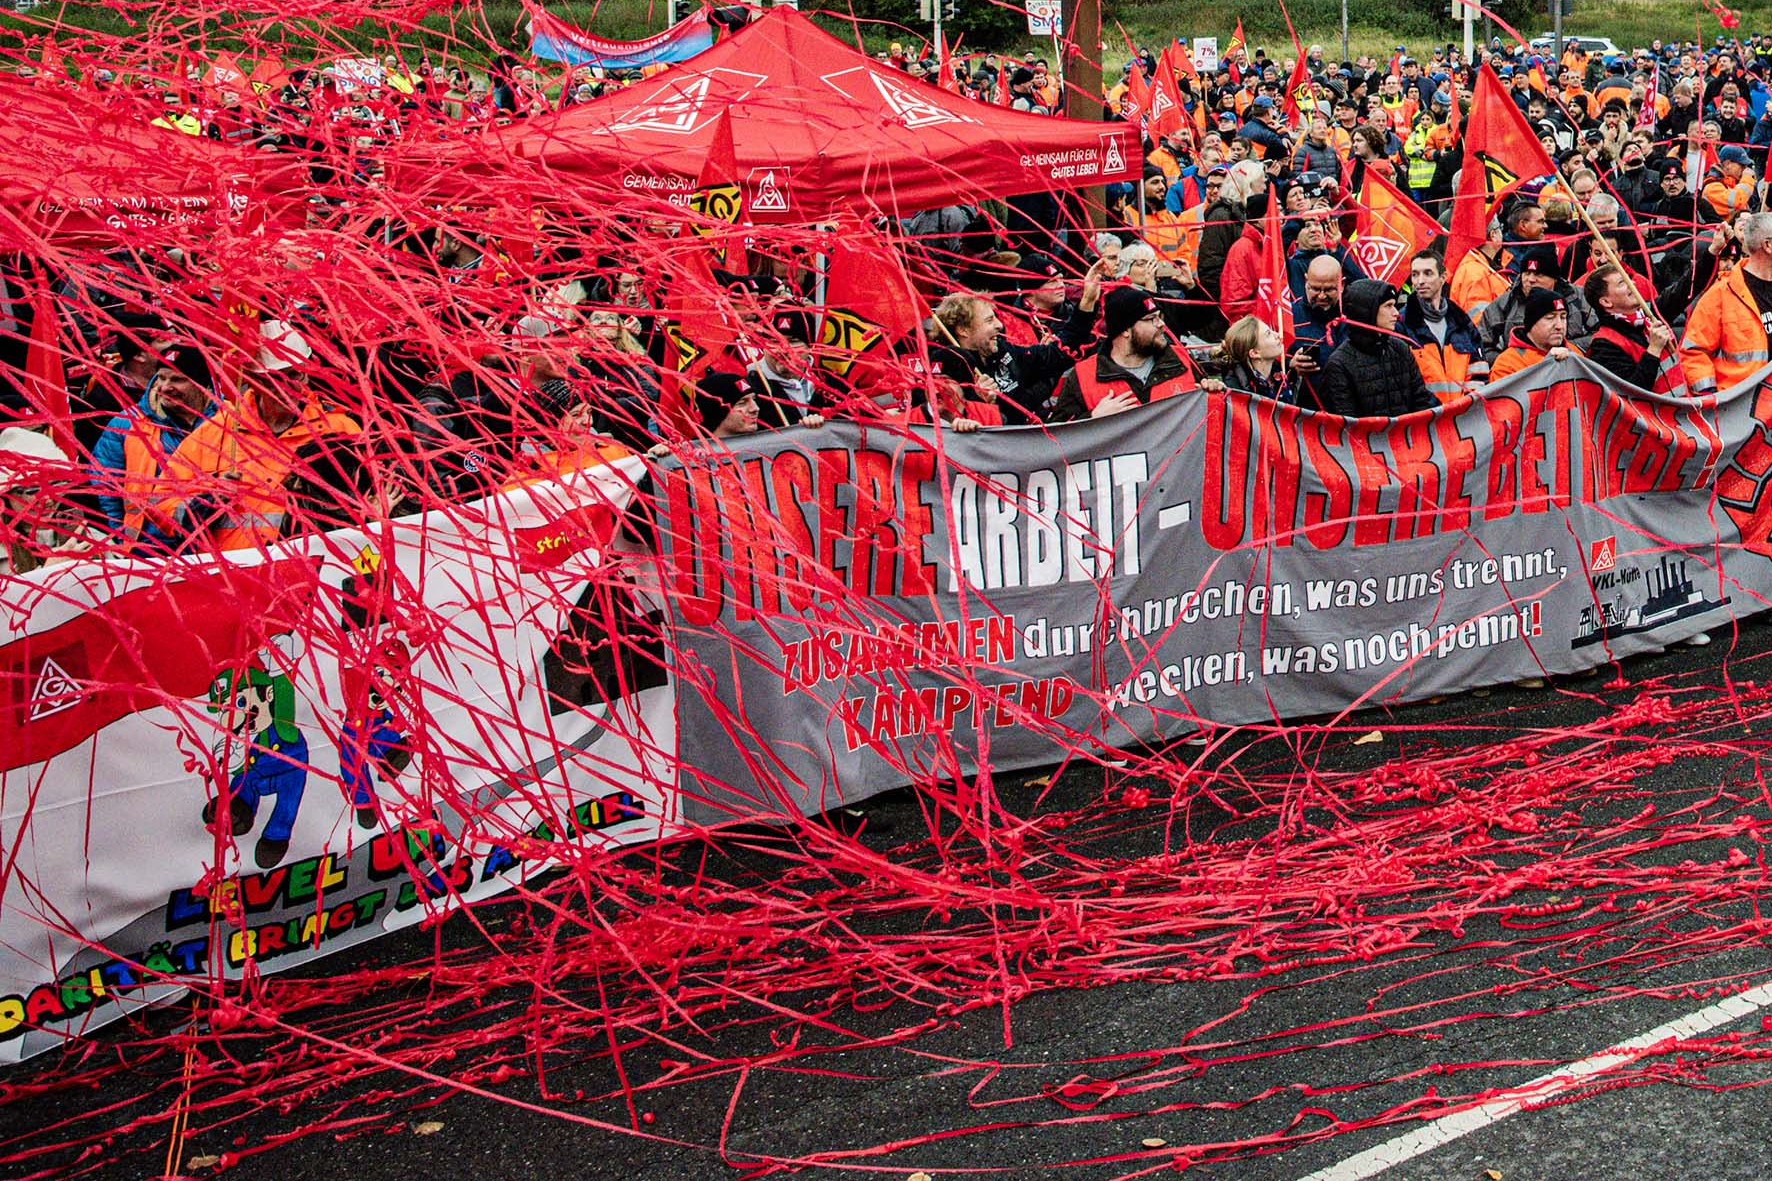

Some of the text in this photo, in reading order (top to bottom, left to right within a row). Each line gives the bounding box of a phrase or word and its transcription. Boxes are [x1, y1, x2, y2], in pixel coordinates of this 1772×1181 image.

[624, 174, 697, 191] GEMEINSAM
[1020, 148, 1098, 166] GEMEINSAM FÜR EIN
[1051, 163, 1099, 179] GUTES LEBEN
[669, 194, 693, 207] GUT
[669, 447, 938, 627] UNSERE
[949, 452, 1148, 592] ARBEIT
[1201, 389, 1476, 550] UNSERE
[1485, 378, 1723, 522] BETRIEBE!
[782, 615, 1016, 696] ZUSAMMEN
[1305, 576, 1378, 612] was
[1385, 568, 1444, 604] uns
[1451, 547, 1568, 590] trennt,
[840, 600, 1542, 753] KÄMPFEND wecken, was noch pennt!
[166, 852, 349, 933] LEVEL
[226, 887, 388, 969] BRINGT
[481, 816, 554, 882] AS
[567, 791, 646, 839] ZIEL
